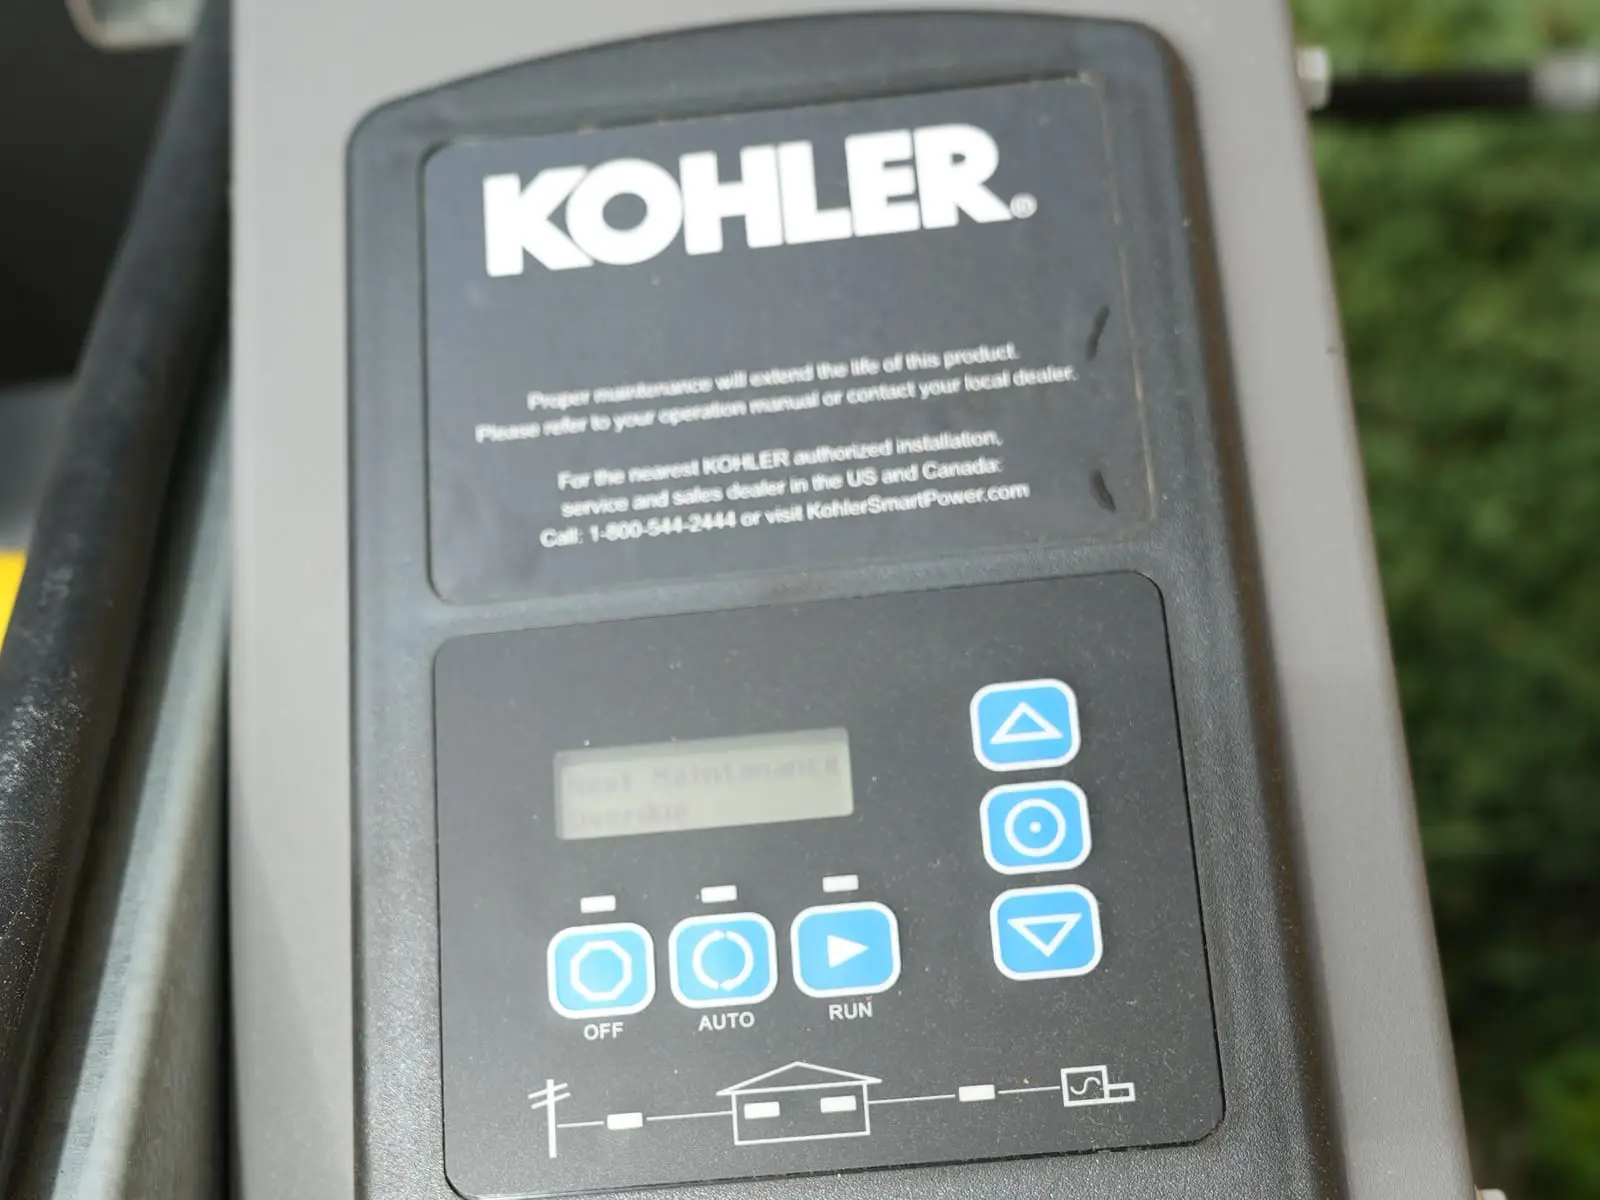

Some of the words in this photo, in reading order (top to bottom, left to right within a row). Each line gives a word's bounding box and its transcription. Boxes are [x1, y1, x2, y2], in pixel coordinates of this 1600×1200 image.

[475, 422, 541, 443] Please
[543, 415, 588, 436] refer
[590, 414, 611, 431] to
[612, 409, 656, 433] your
[657, 399, 747, 426] operation
[749, 389, 819, 415] manual
[821, 389, 844, 407] or
[846, 380, 916, 405] contact
[918, 377, 962, 400] your
[964, 369, 1011, 391] local
[1012, 363, 1079, 387] dealer.
[526, 390, 590, 411] Proper
[593, 376, 713, 403] maintenance
[714, 369, 747, 390] will
[749, 363, 815, 388] extend
[817, 362, 848, 380] the
[850, 355, 880, 377] life
[882, 353, 902, 373] of
[906, 350, 941, 371] this
[943, 341, 1020, 371] product.
[557, 470, 592, 490] For
[594, 467, 626, 487] the
[628, 459, 700, 483] nearest
[702, 448, 790, 475] KOHLER
[793, 437, 893, 466] authorized
[896, 430, 1004, 455] installation,
[539, 527, 584, 549] Call:
[588, 509, 737, 543] 1-800-544-2444
[740, 511, 763, 528] or
[764, 504, 804, 525] visit
[807, 482, 1030, 520] KohlerSmartPower.com
[560, 496, 629, 518] service
[631, 489, 669, 511] and
[671, 484, 724, 507] sales
[726, 478, 786, 500] dealer
[789, 476, 809, 495] in
[811, 472, 843, 491] the
[846, 466, 878, 488] US
[881, 462, 919, 485] and
[582, 1021, 624, 1041] OFF
[698, 1011, 755, 1032] AUTO
[828, 1001, 873, 1021] RUN
